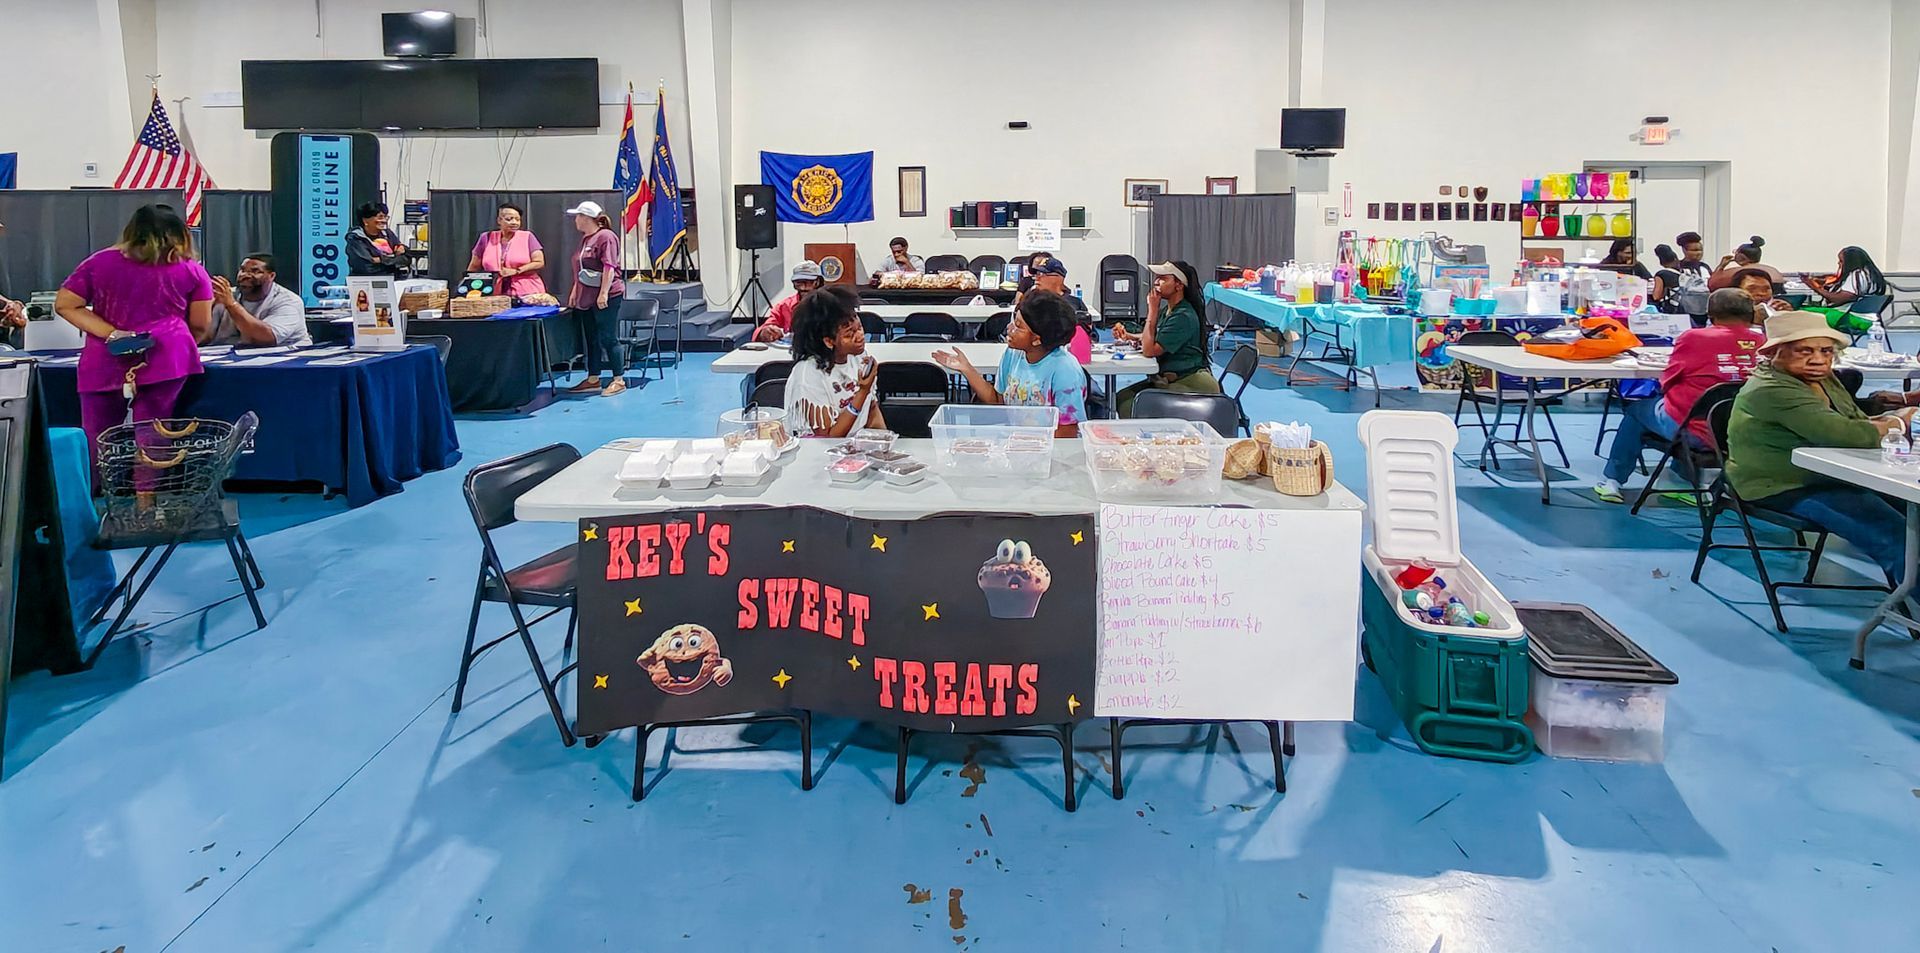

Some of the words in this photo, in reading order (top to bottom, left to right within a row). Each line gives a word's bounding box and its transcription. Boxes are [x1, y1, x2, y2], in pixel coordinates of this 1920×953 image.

[312, 151, 321, 184] CRISIS
[324, 151, 339, 237] LIFELINE
[312, 197, 320, 237] SUICIDE
[1207, 507, 1251, 529] Cake
[1258, 511, 1281, 533] $5
[606, 512, 731, 581] KEY'S
[1102, 555, 1154, 574] Chocolate
[1158, 552, 1188, 569] Cake
[1195, 553, 1212, 569] $5
[1106, 530, 1177, 557] Strawberry
[1247, 535, 1271, 552] $5
[737, 577, 870, 646] SWEET
[874, 656, 1039, 717] TREATS
